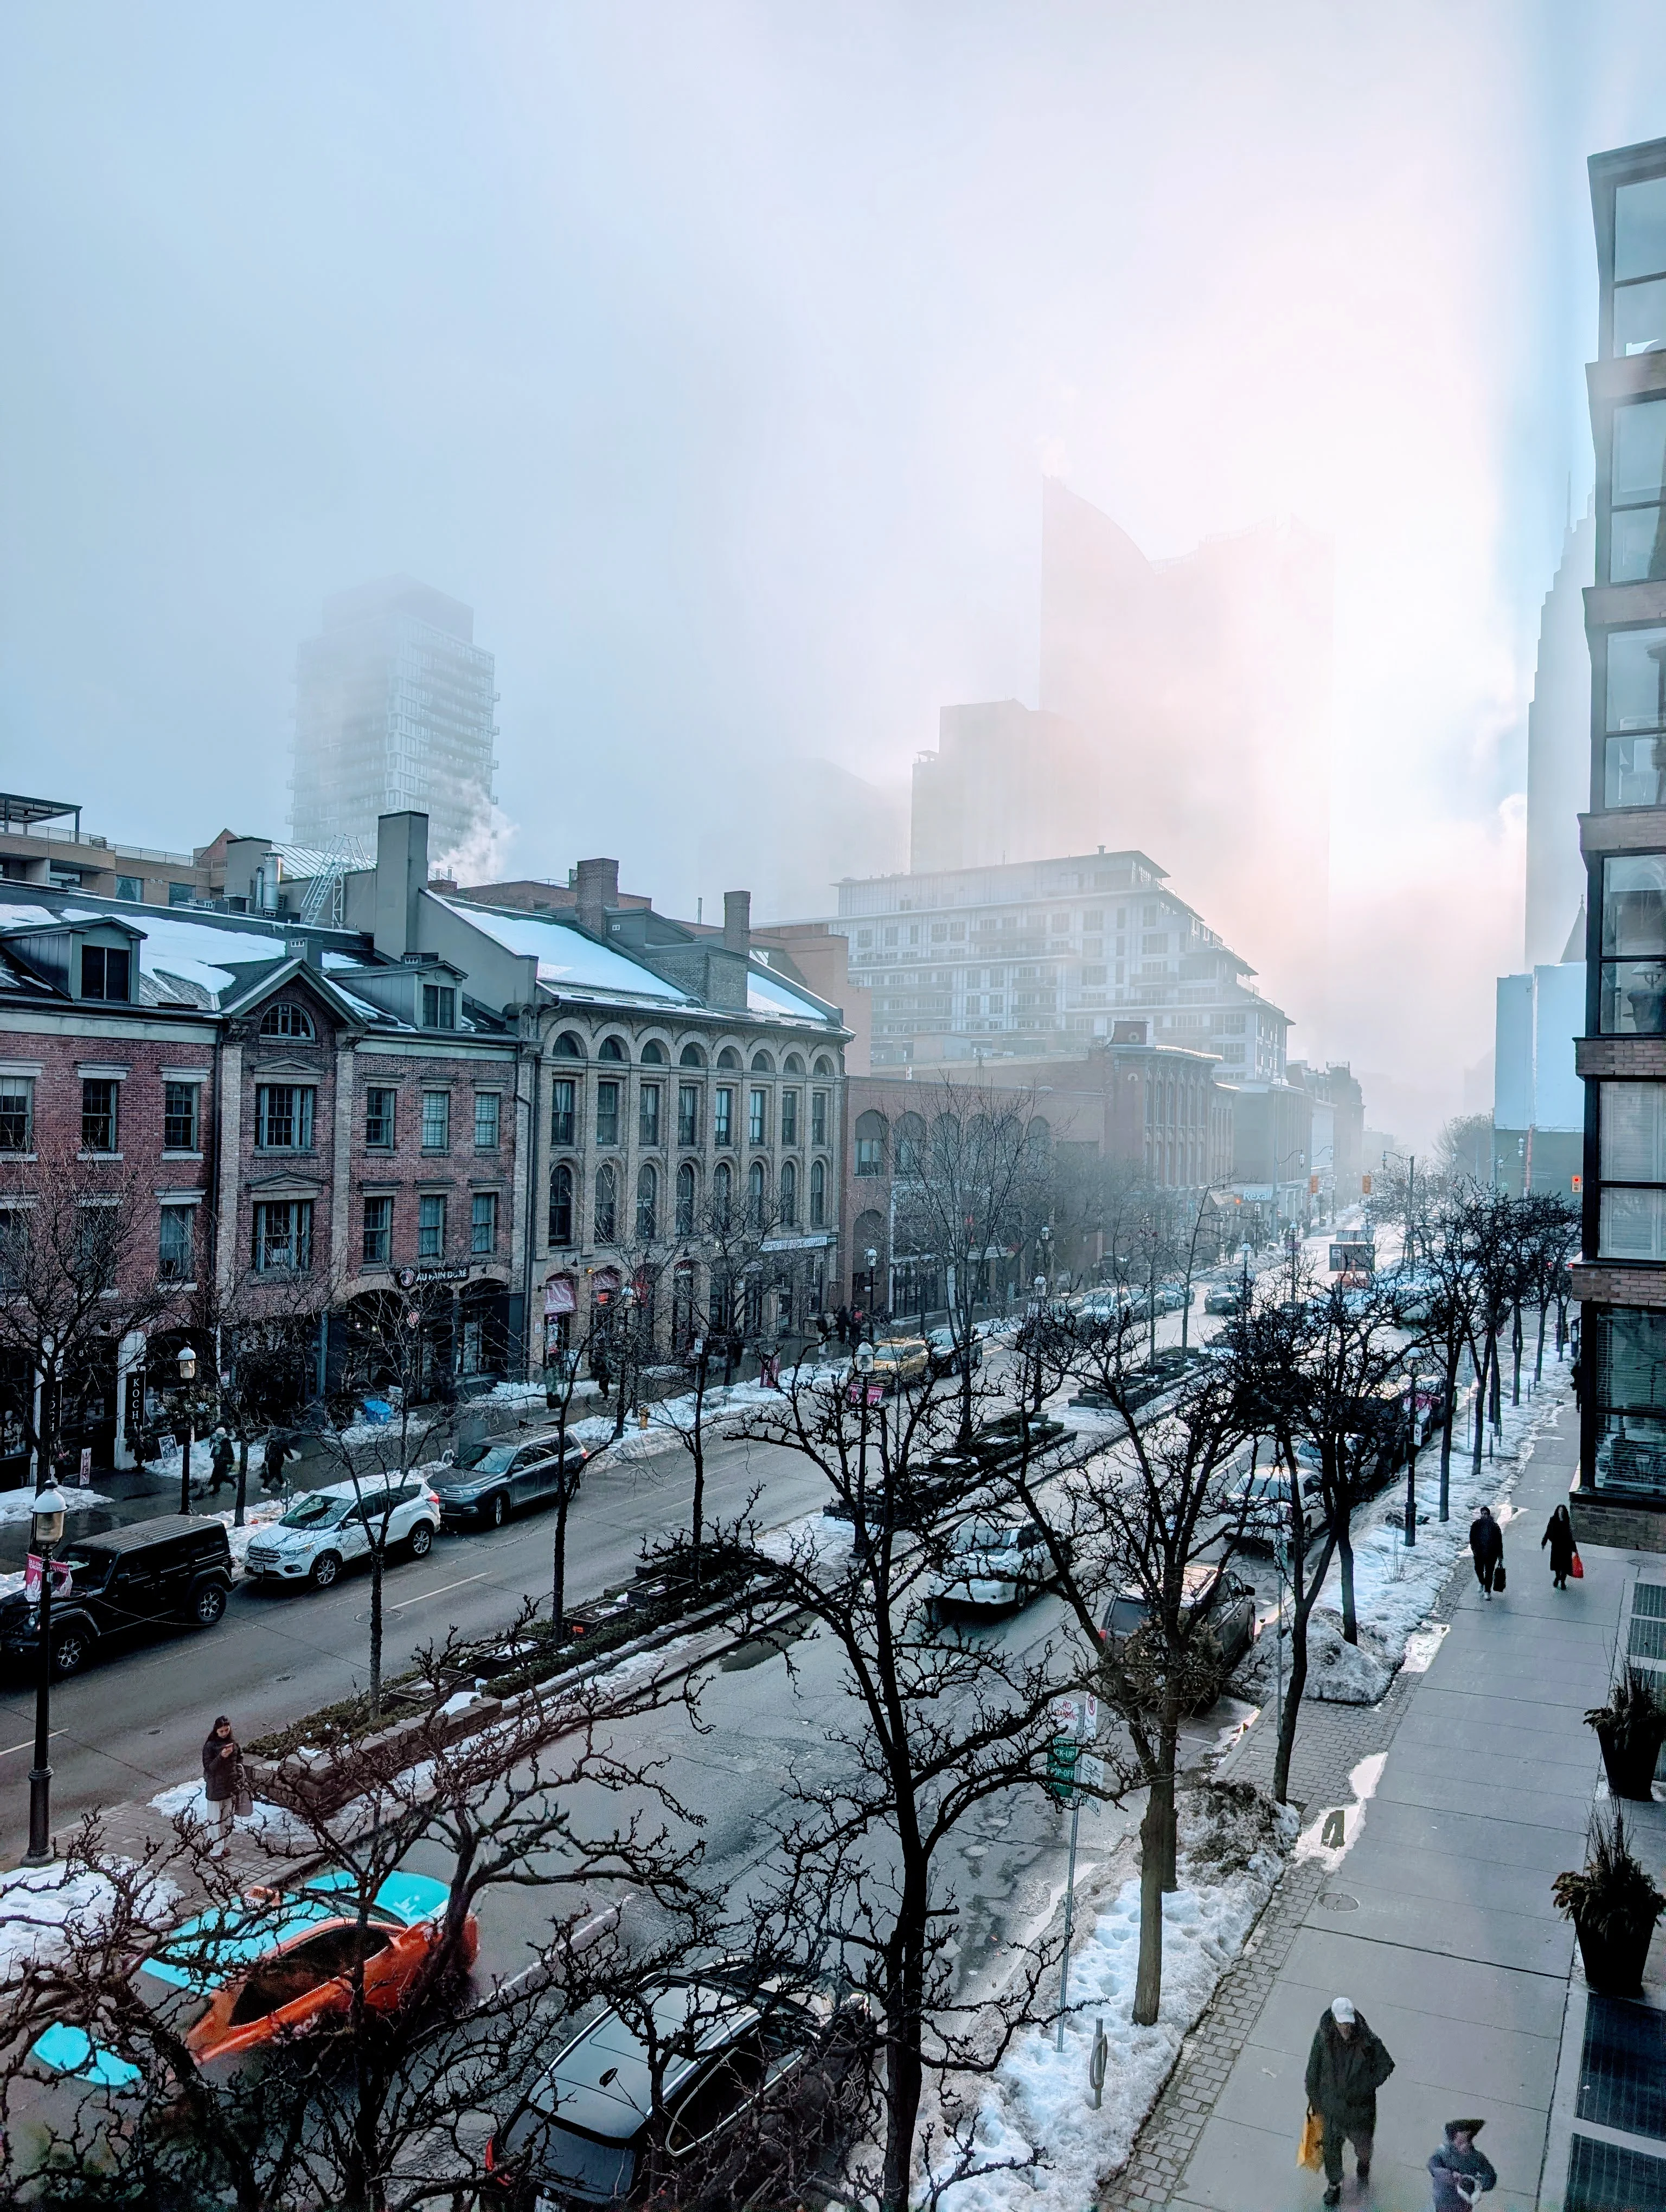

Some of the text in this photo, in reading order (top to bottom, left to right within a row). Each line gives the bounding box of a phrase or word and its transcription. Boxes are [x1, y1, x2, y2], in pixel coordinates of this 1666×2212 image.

[1243, 1191, 1272, 1202] Rexall
[416, 1273, 427, 1282] AU
[1063, 1701, 1072, 1710] NO
